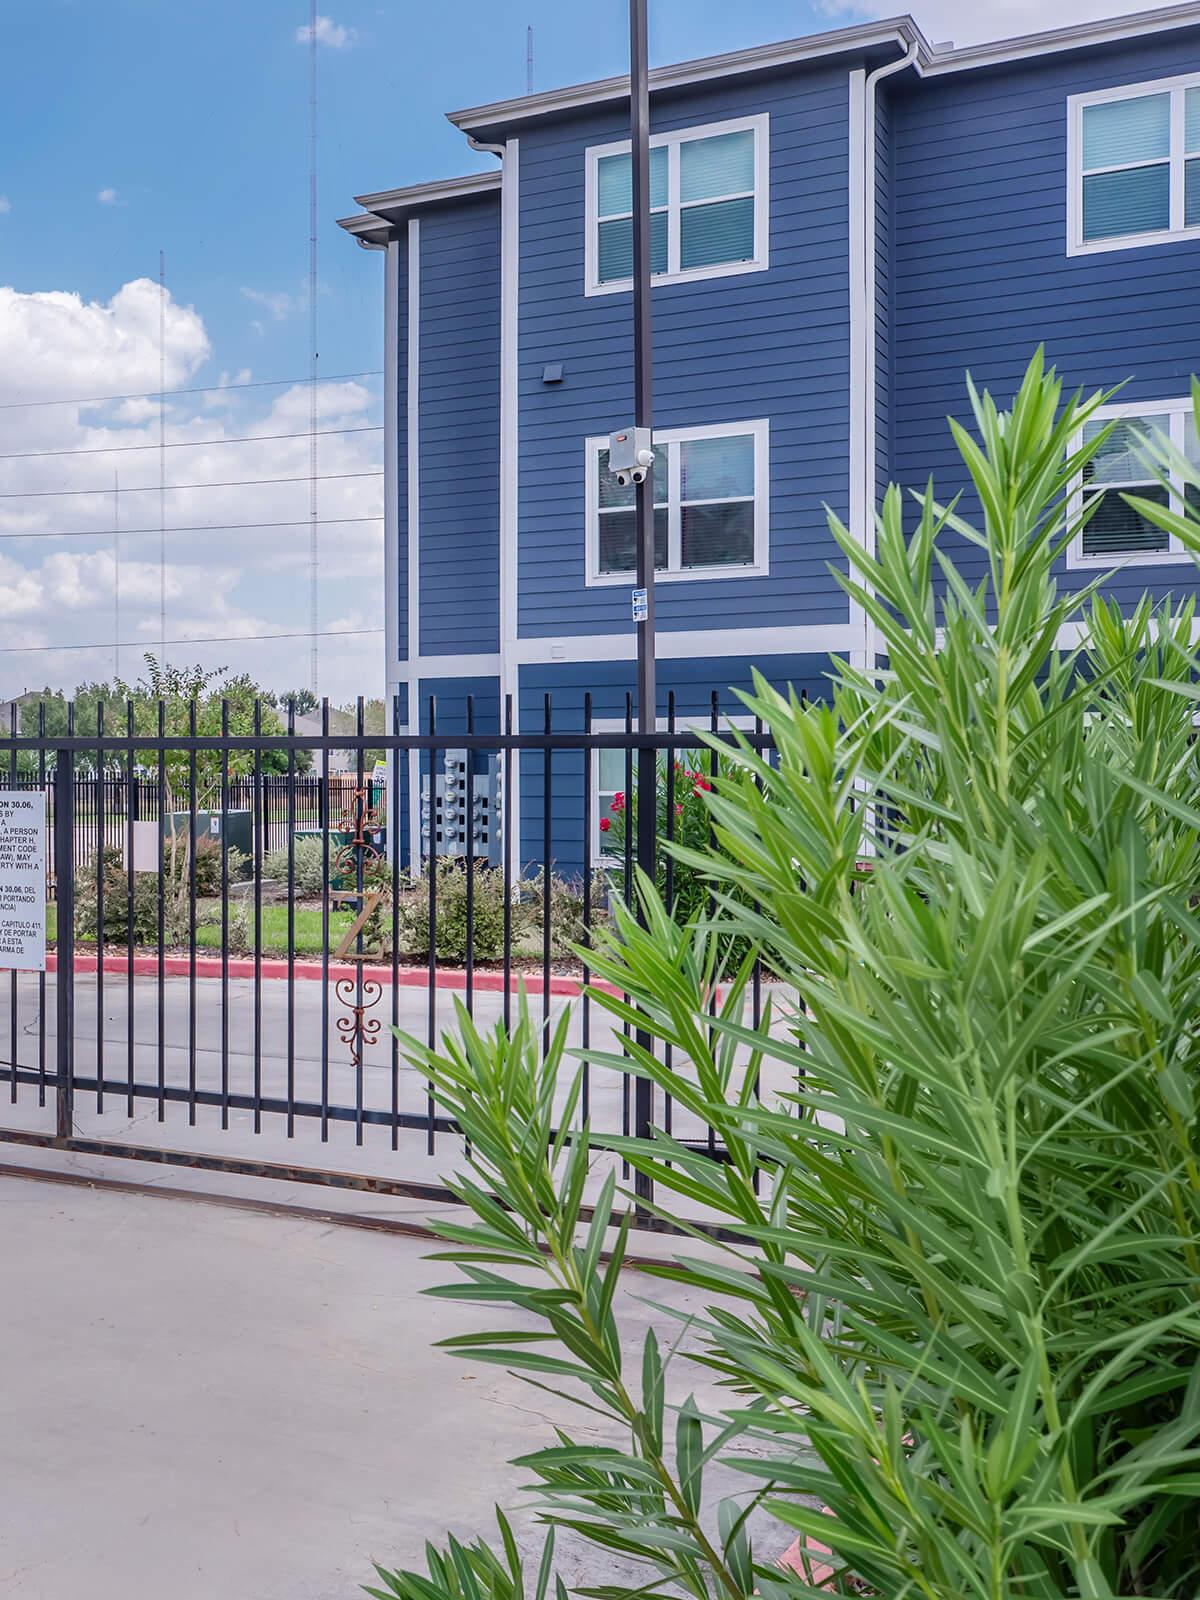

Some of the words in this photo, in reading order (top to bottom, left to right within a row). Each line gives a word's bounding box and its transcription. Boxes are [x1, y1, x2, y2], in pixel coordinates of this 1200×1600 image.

[10, 828, 39, 836] PERSON
[18, 845, 37, 853] CODE
[16, 854, 31, 862] MAY
[15, 862, 33, 870] WITH
[24, 886, 37, 894] DEL
[3, 895, 36, 904] PORTANDO
[13, 930, 38, 938] PORTAR
[2, 937, 7, 945] A
[8, 938, 23, 946] ESTA
[0, 946, 16, 954] ARMA
[16, 947, 24, 955] DE
